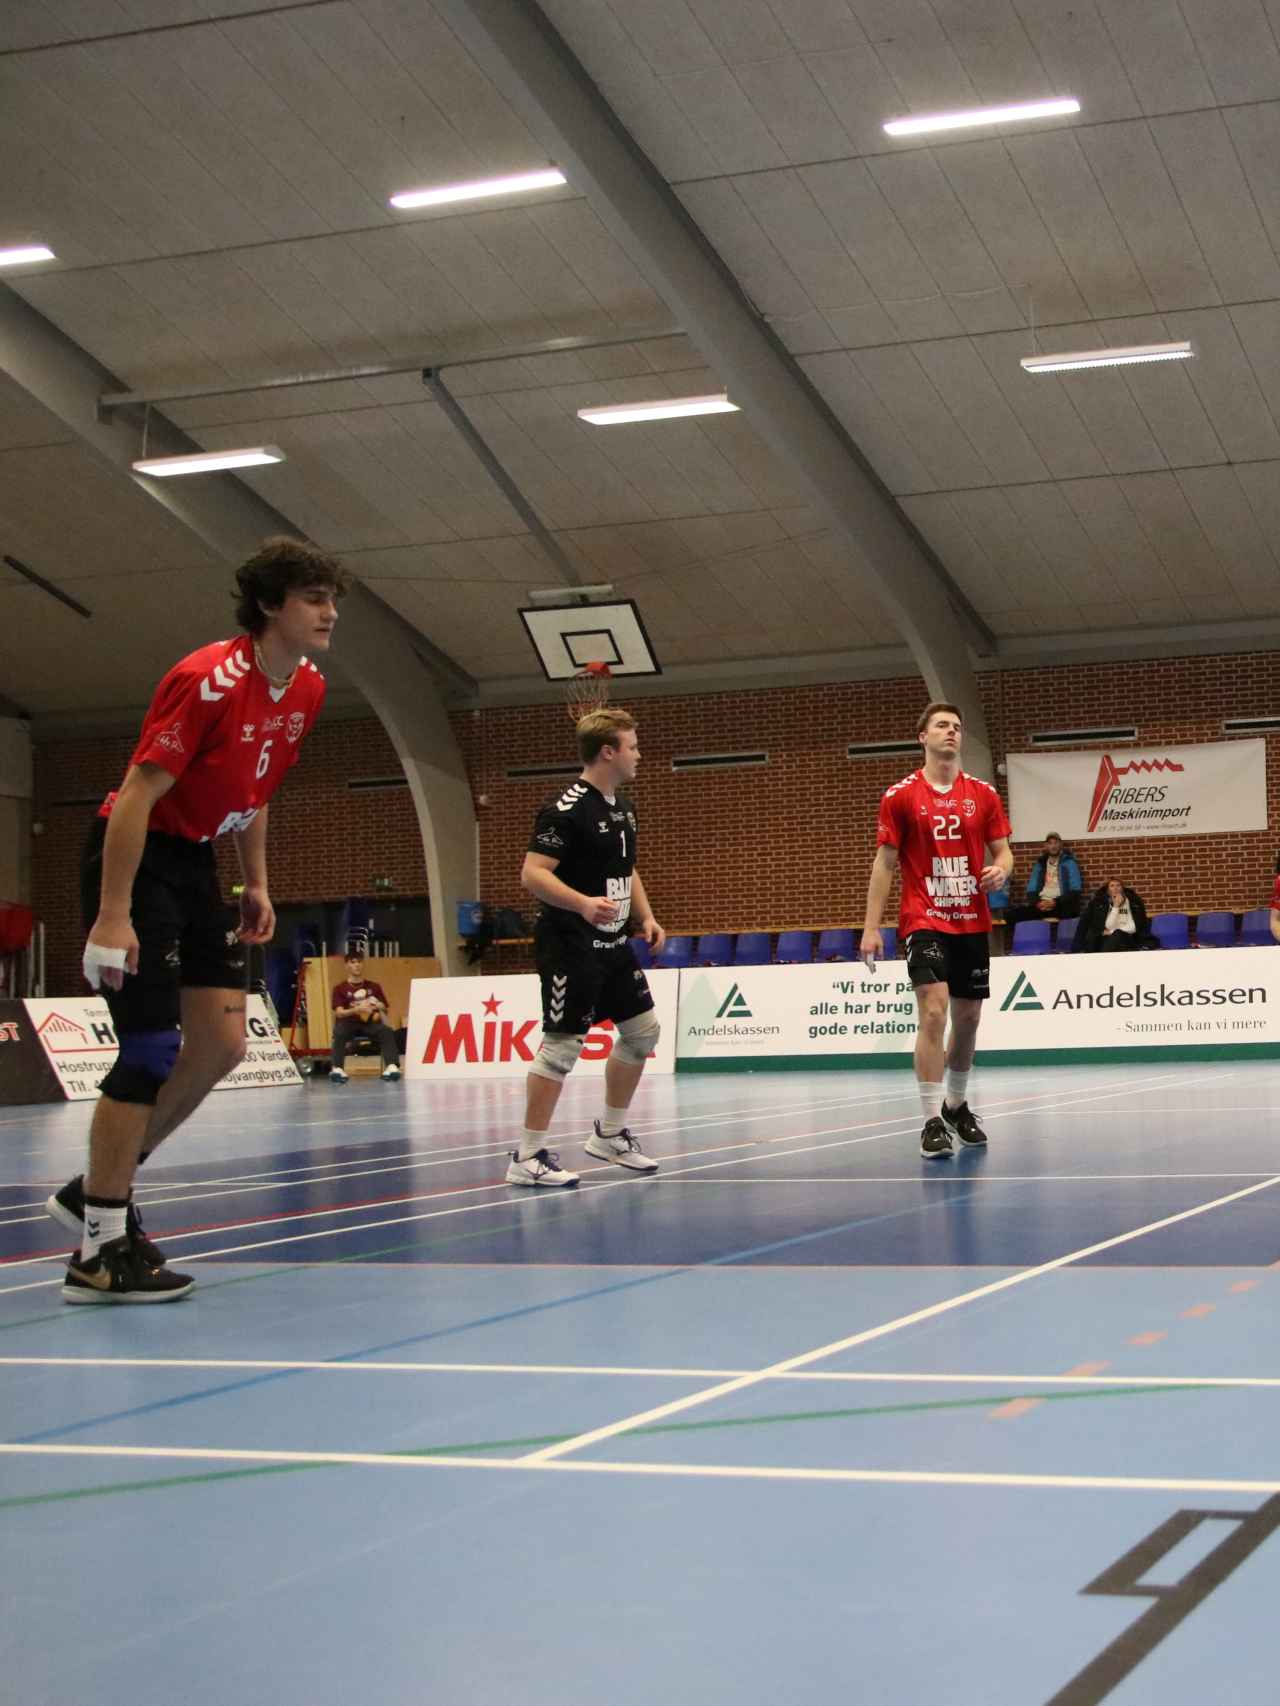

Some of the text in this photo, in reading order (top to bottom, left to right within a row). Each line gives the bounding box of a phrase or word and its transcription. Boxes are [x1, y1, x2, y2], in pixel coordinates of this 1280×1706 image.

[256, 739, 273, 780] 6
[1107, 786, 1168, 804] RIBERS
[1101, 805, 1192, 821] Maskinimport
[933, 815, 961, 840] 22
[620, 830, 626, 857] 1
[932, 856, 969, 877] BLUE
[925, 876, 978, 897] WATER
[860, 982, 891, 993] tror
[1052, 983, 1267, 1010] Andelskassen
[809, 999, 914, 1017] alle har brug
[687, 1023, 780, 1037] Andelskassen
[808, 1022, 848, 1039] gode
[1125, 1020, 1182, 1033] Sammen
[1186, 1018, 1211, 1031] kan
[1215, 1018, 1228, 1030] vi
[1232, 1018, 1267, 1030] mere
[257, 1049, 290, 1061] Varde
